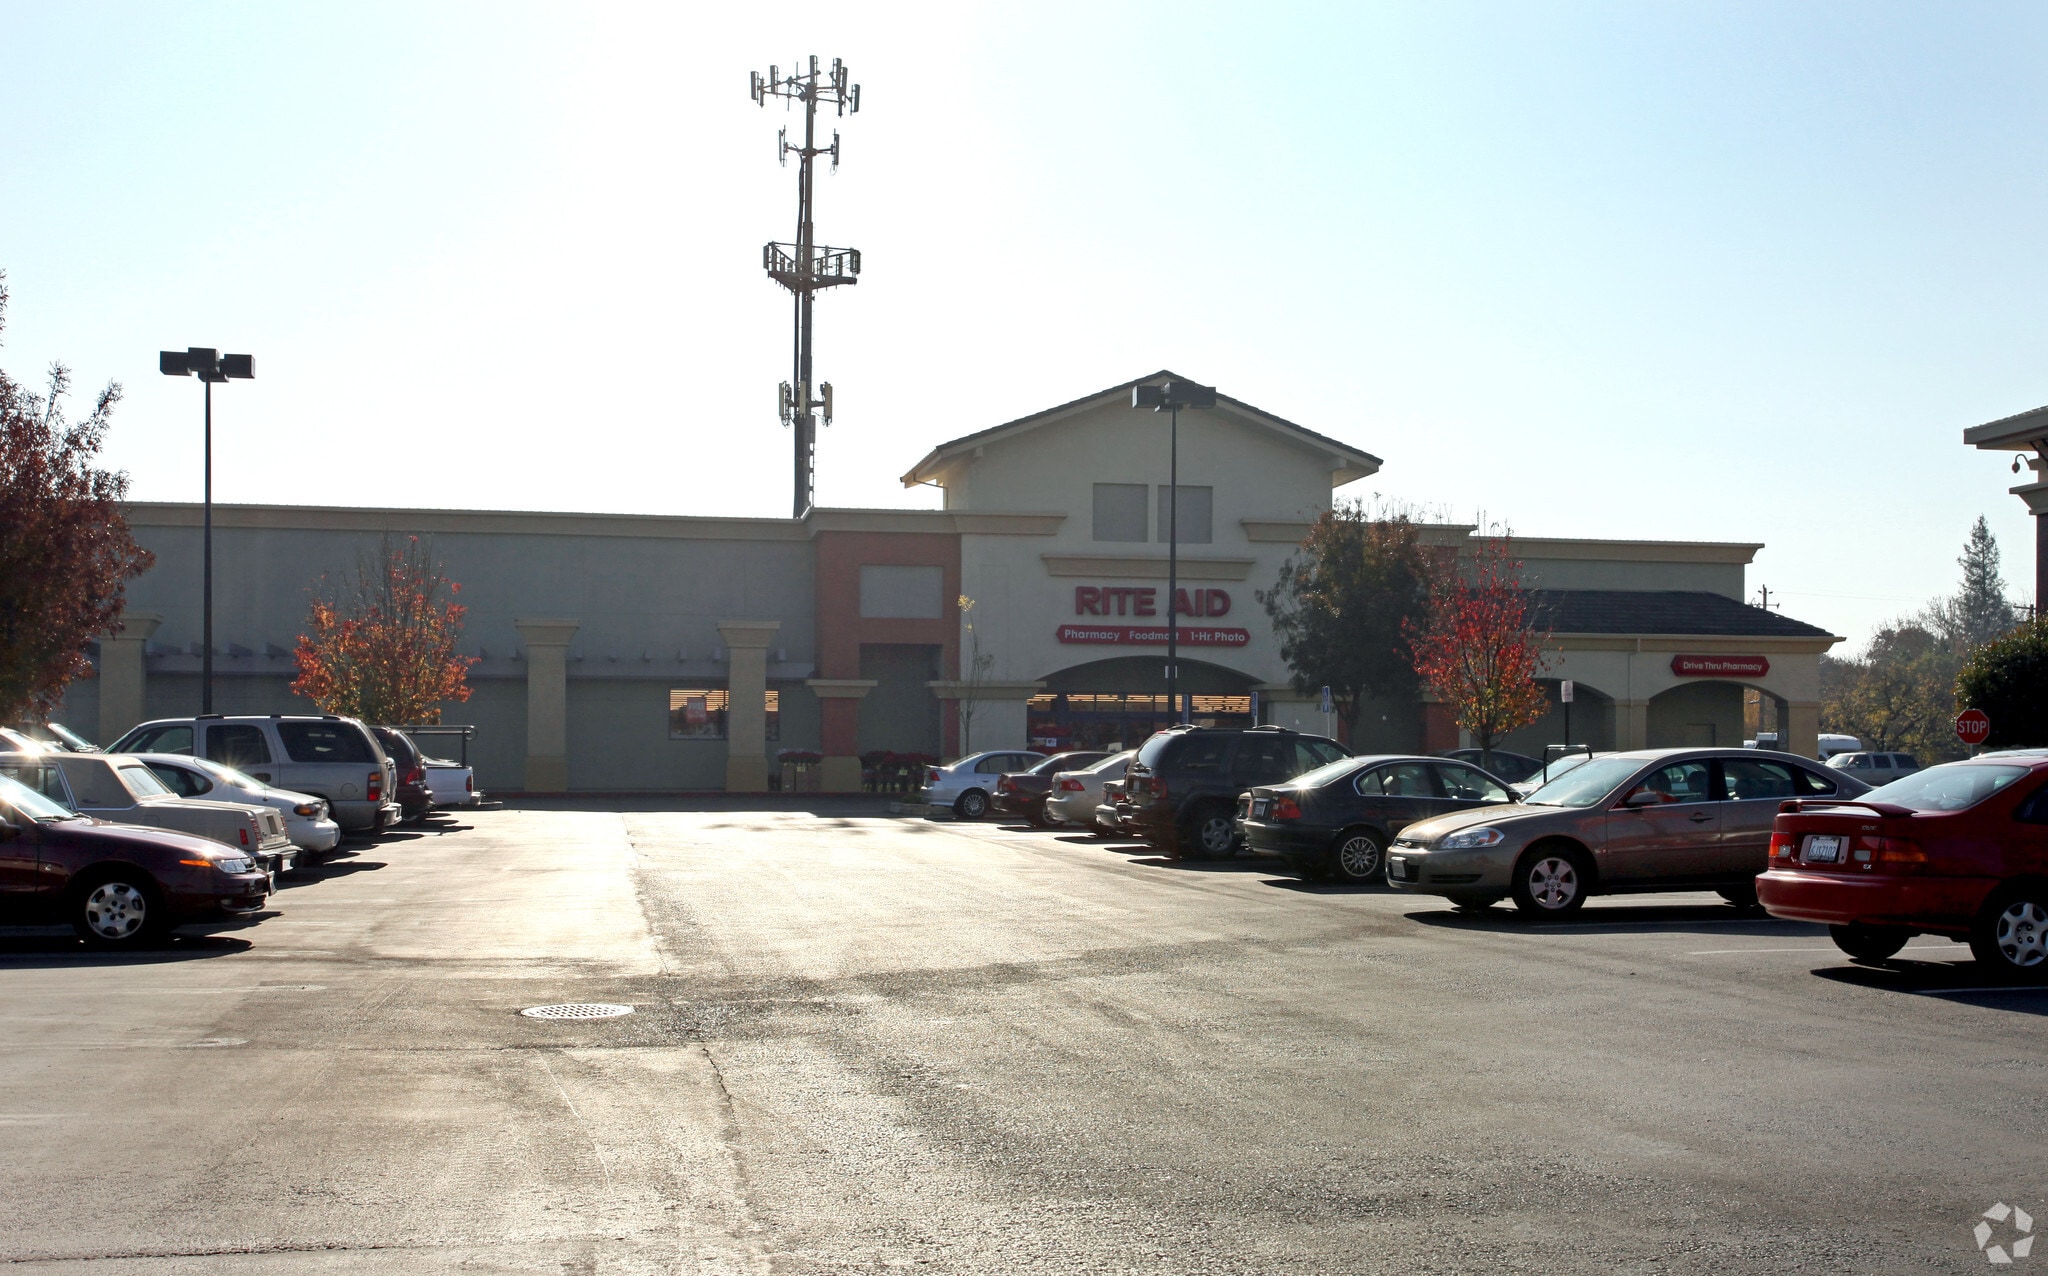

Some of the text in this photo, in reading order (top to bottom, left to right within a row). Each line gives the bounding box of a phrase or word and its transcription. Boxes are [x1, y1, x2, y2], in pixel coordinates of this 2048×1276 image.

[1075, 586, 1231, 617] RITE AID
[1064, 629, 1245, 642] Pharmacy Foodmat 1-Hr. Photo
[1683, 661, 1762, 671] Drive Thru Pharmacy
[1958, 720, 1987, 734] STOP
